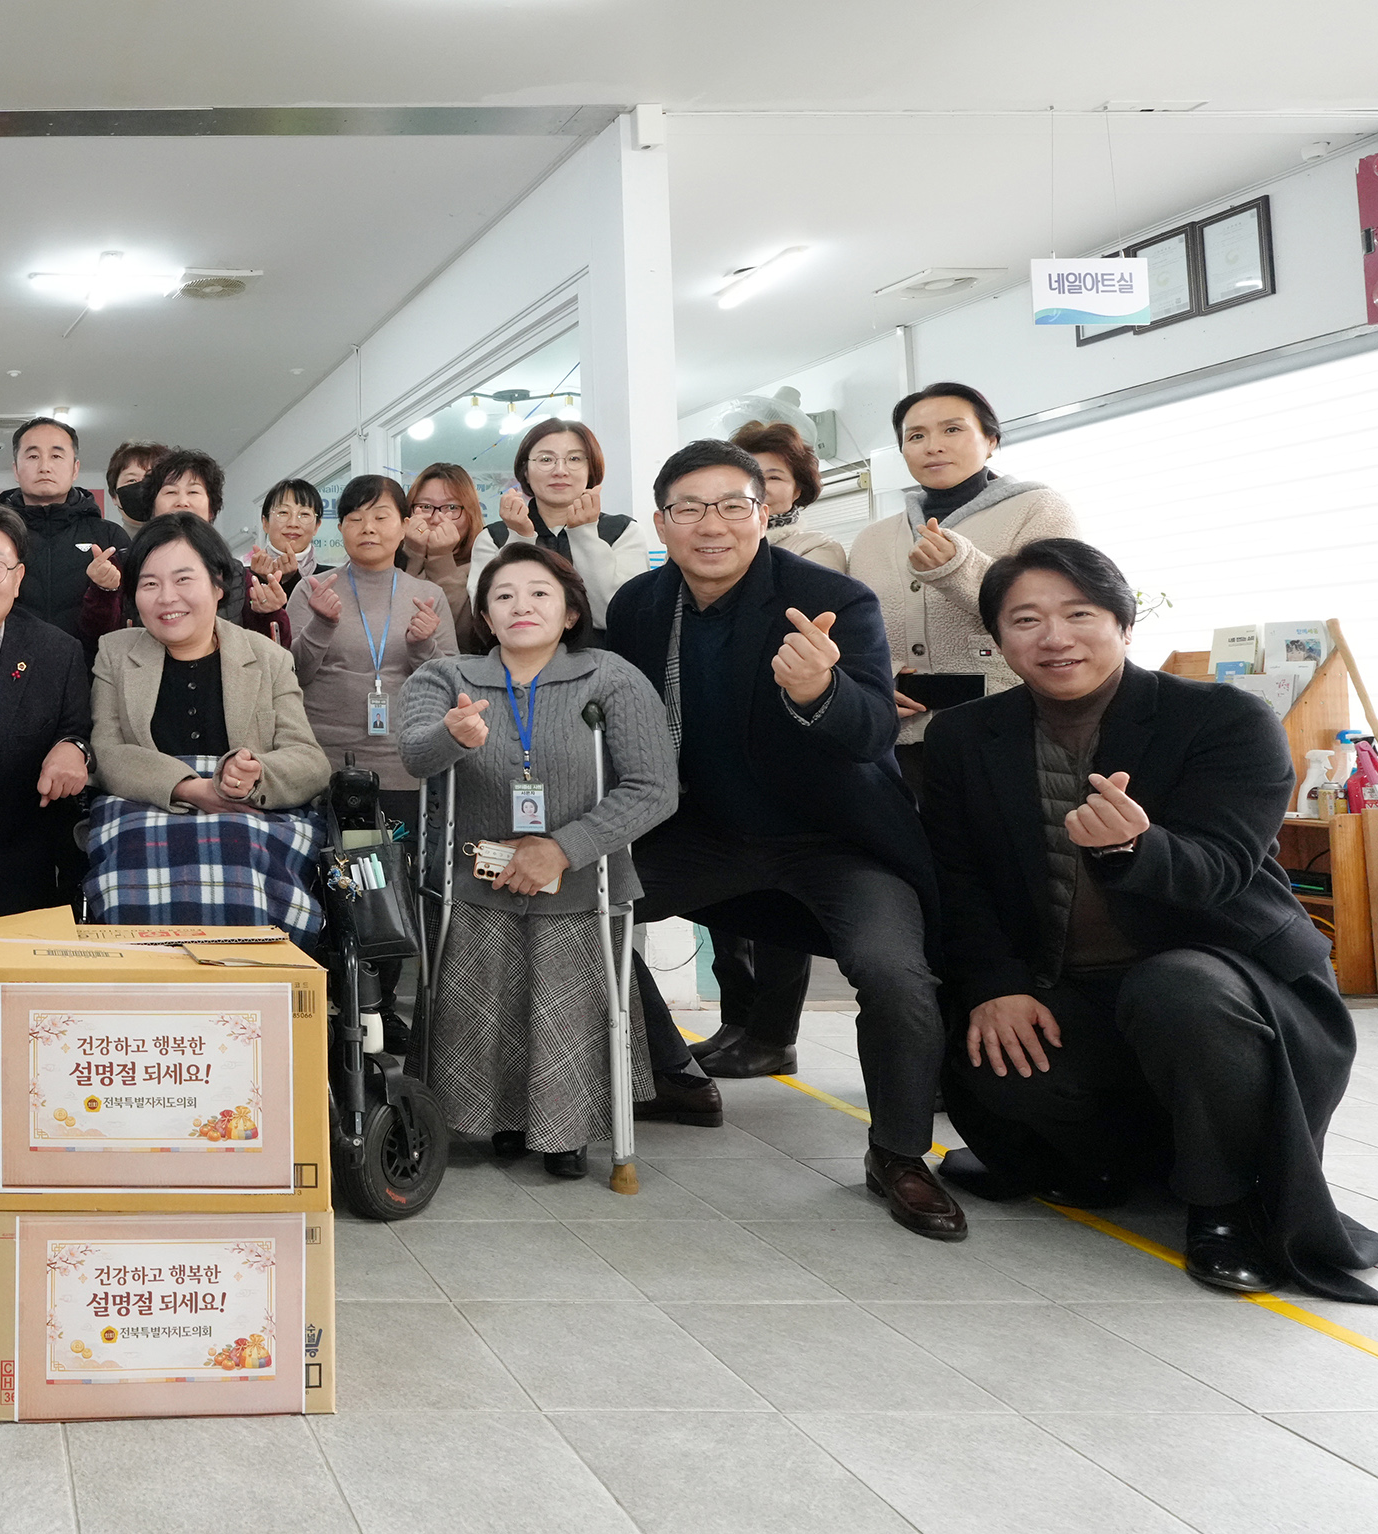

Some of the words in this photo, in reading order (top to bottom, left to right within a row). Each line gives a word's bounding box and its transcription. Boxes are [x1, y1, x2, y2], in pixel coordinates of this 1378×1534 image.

[1048, 272, 1134, 295] 네일아트실
[77, 1035, 148, 1056] 건강하고
[152, 1035, 205, 1056] 행복한
[69, 1062, 137, 1087] 설명절
[142, 1062, 212, 1085] 되세요!
[103, 1096, 197, 1109] 전북특별자치도의회
[94, 1266, 165, 1286] 건강하고
[169, 1264, 222, 1285] 행복한
[86, 1291, 154, 1317] 설명절
[158, 1292, 227, 1315] 되세요!
[120, 1325, 212, 1339] 전북특별자치도의회
